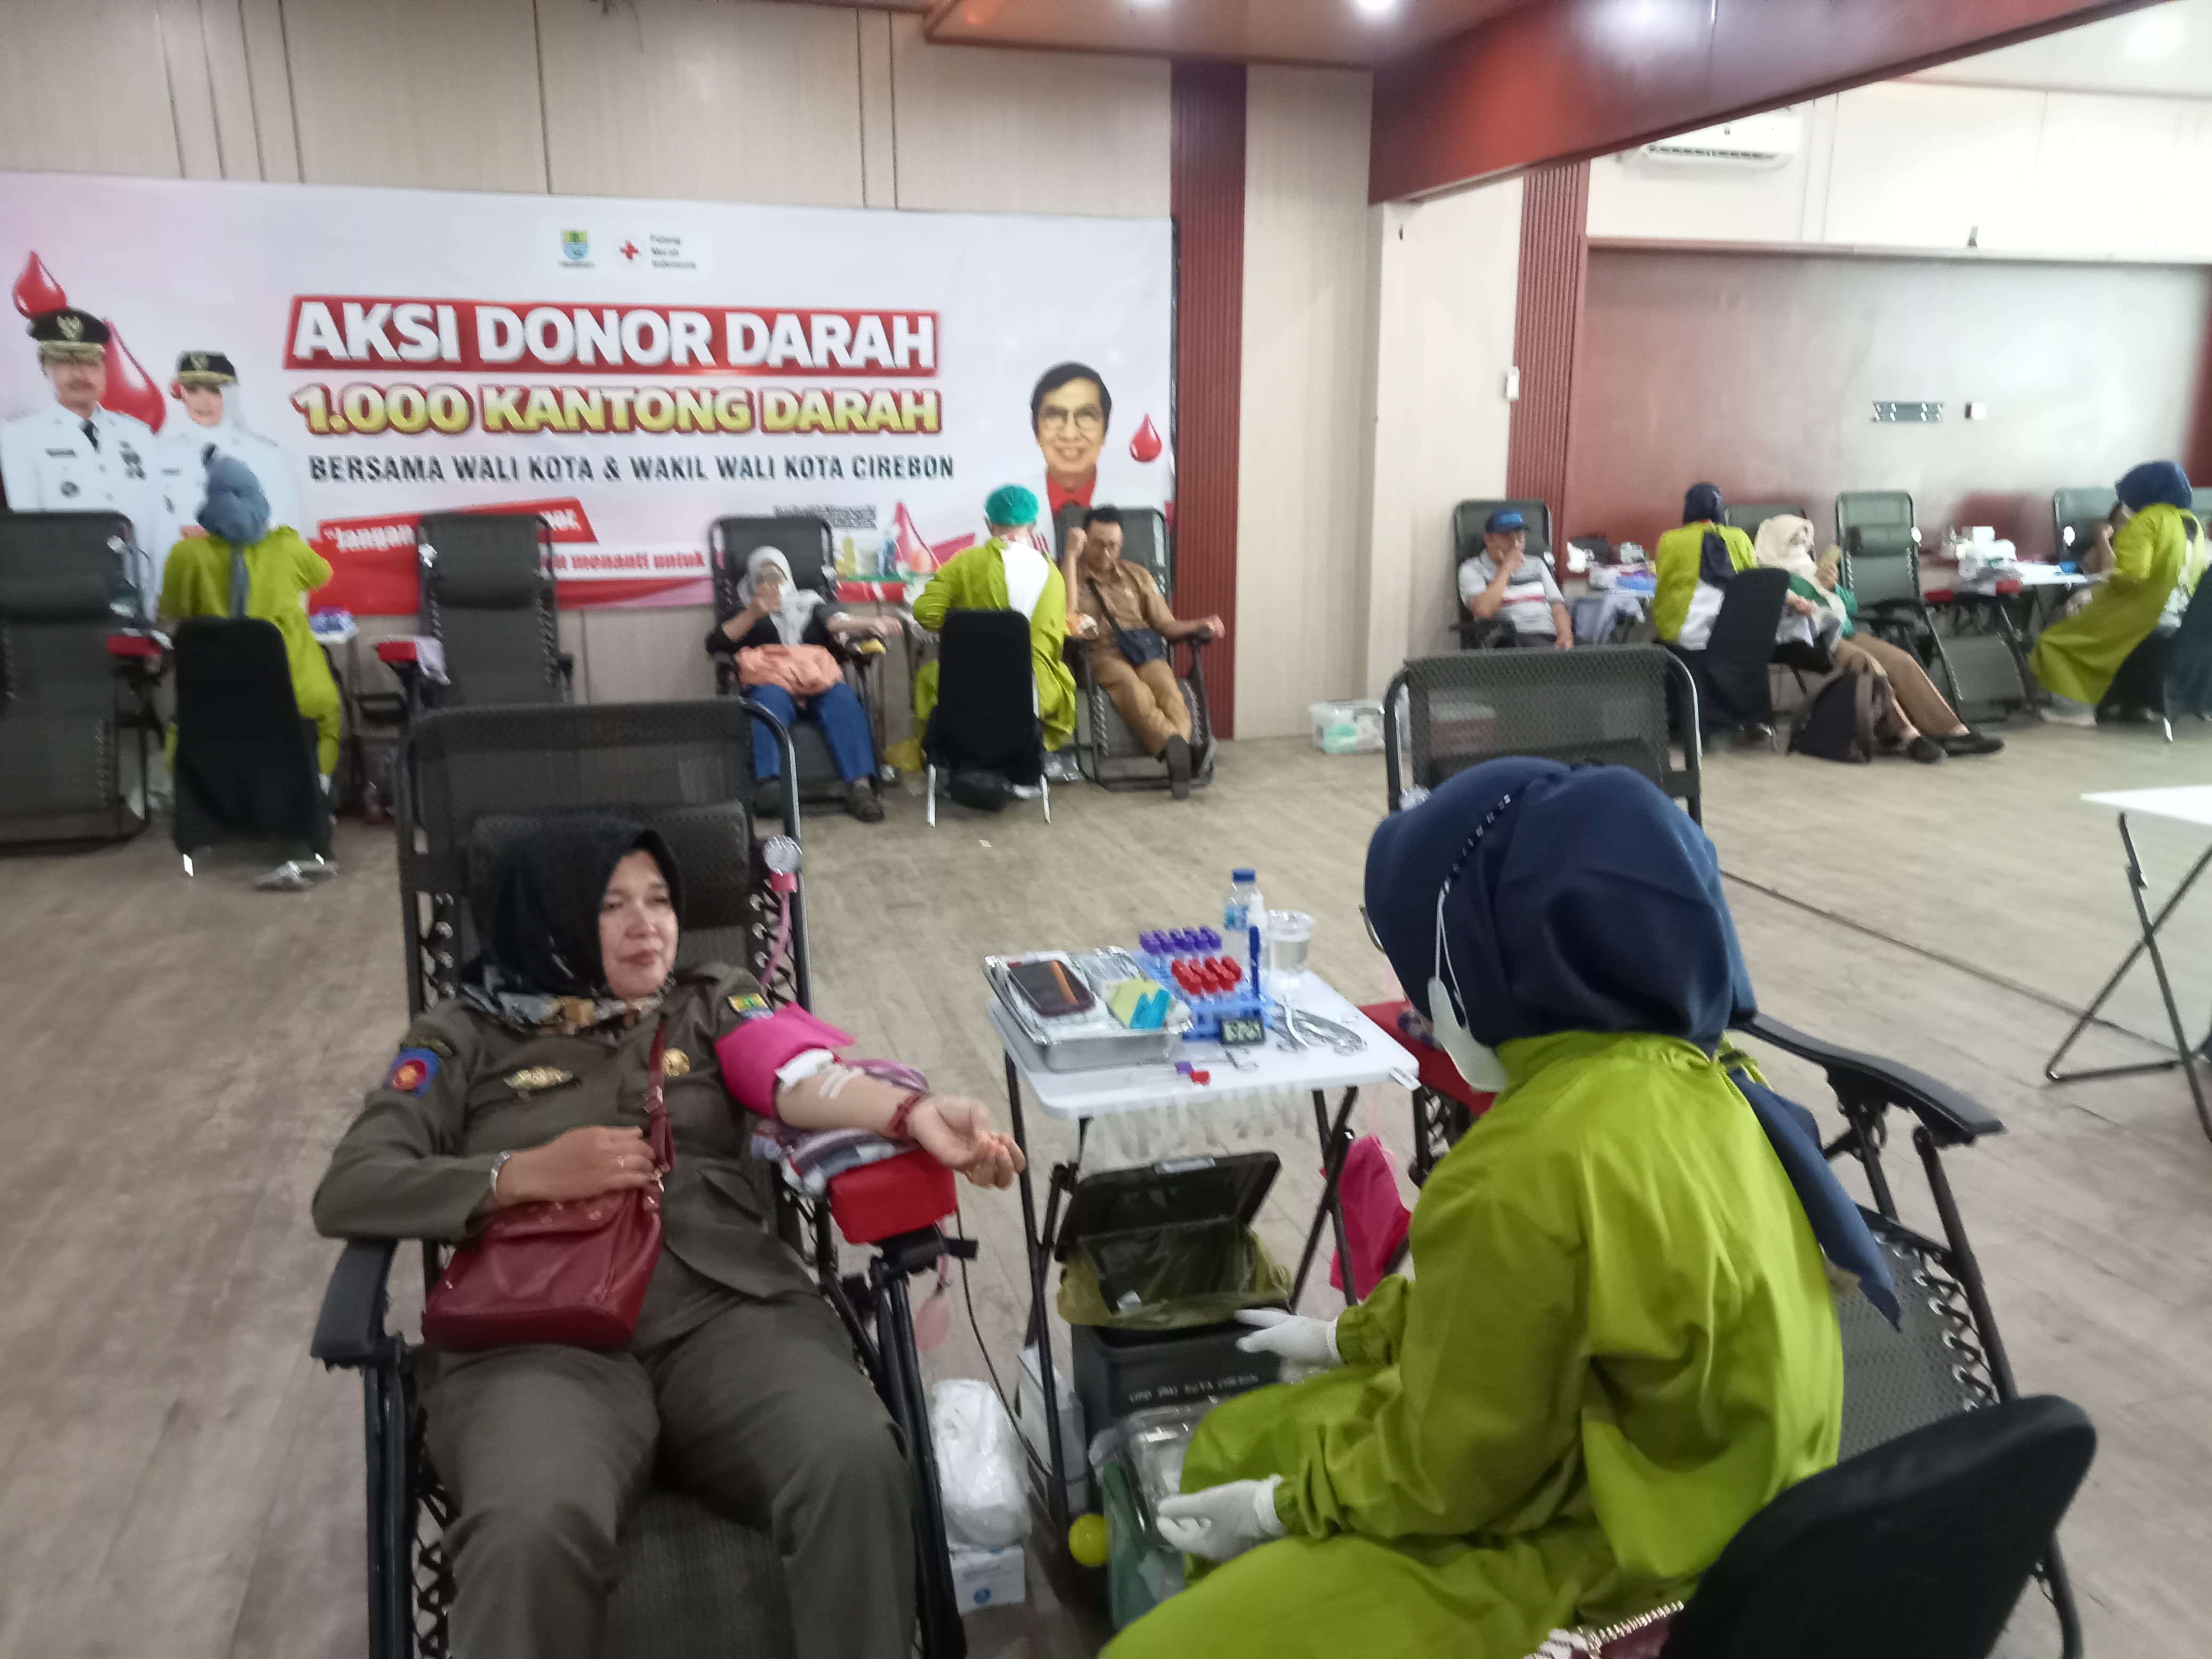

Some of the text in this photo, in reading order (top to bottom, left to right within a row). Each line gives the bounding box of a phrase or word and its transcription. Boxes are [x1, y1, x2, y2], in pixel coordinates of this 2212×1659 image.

[292, 300, 935, 370] AKSI DONOR DARAH
[293, 386, 939, 433] 1.000 KANTONG DARAH
[308, 455, 954, 482] BERSAMA WALI KOTA & WAKIL WALI KOTA CIREBON
